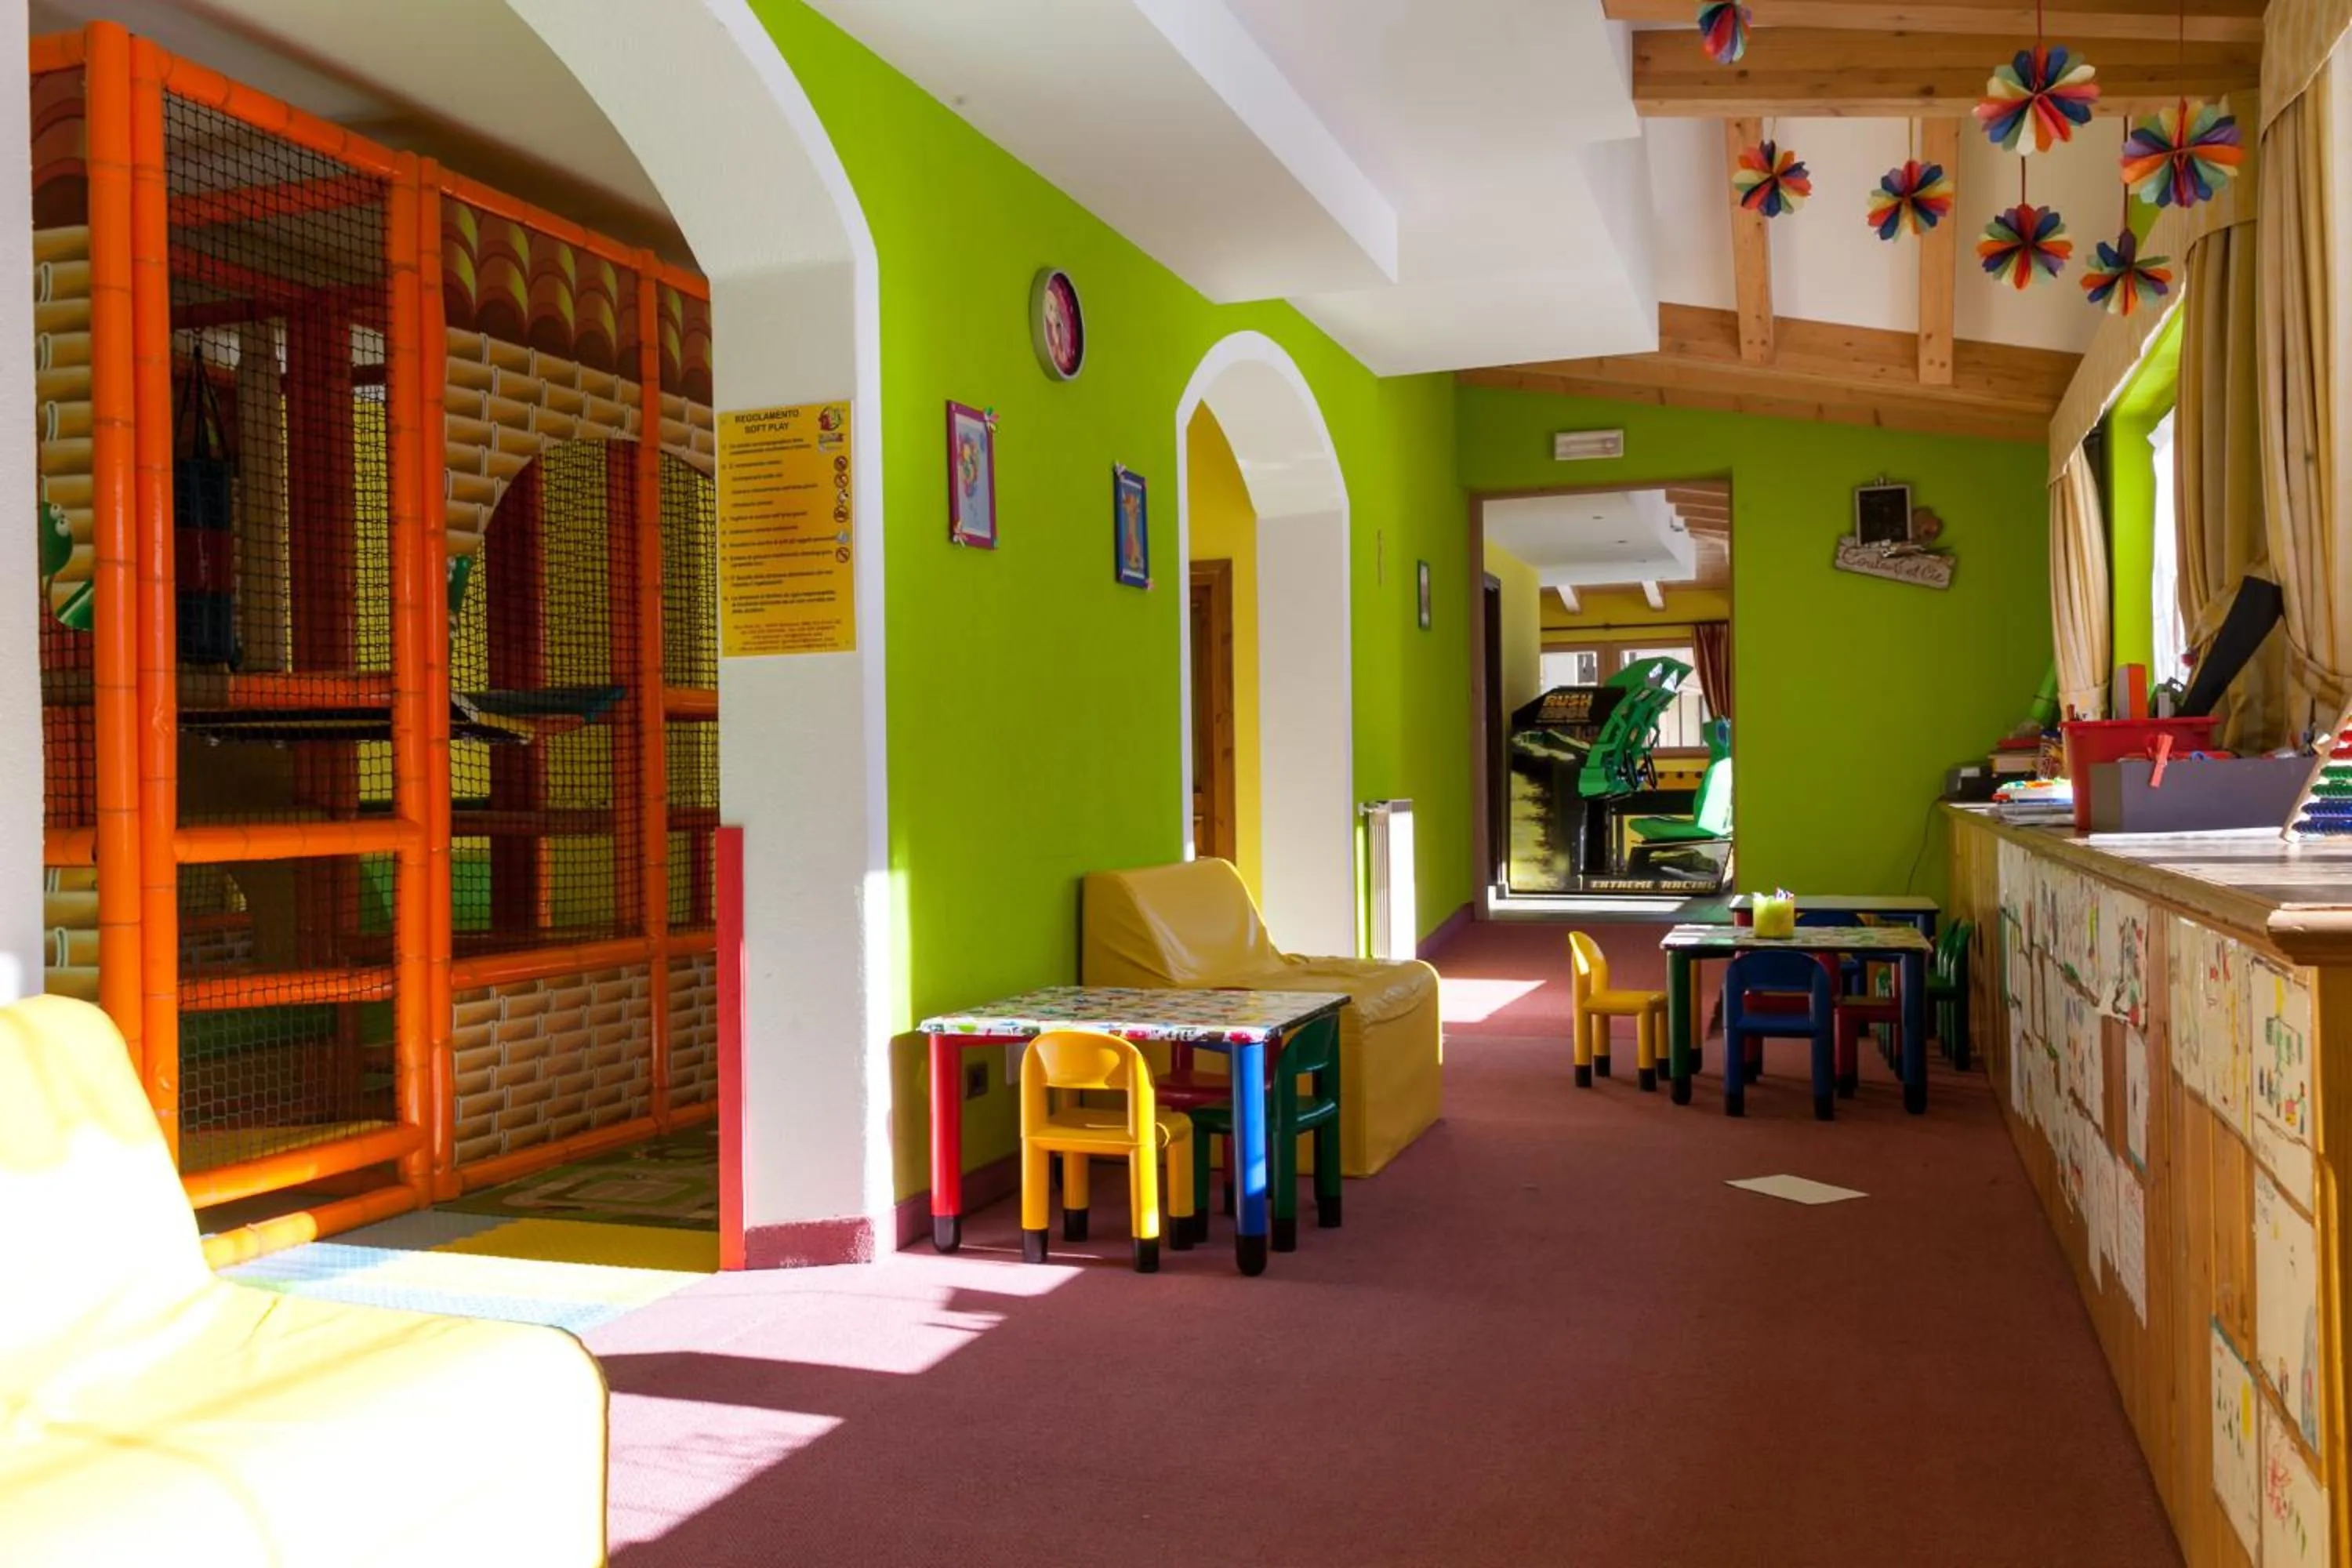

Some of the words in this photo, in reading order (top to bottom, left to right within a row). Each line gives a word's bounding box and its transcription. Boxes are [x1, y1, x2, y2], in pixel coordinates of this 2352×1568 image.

[735, 408, 800, 423] REGOLAMENTO
[744, 424, 766, 434] SOFT
[768, 422, 789, 431] PLAY
[1542, 692, 1593, 706] RUSH
[1590, 880, 1654, 889] EXTREME
[1660, 880, 1717, 889] RACING
